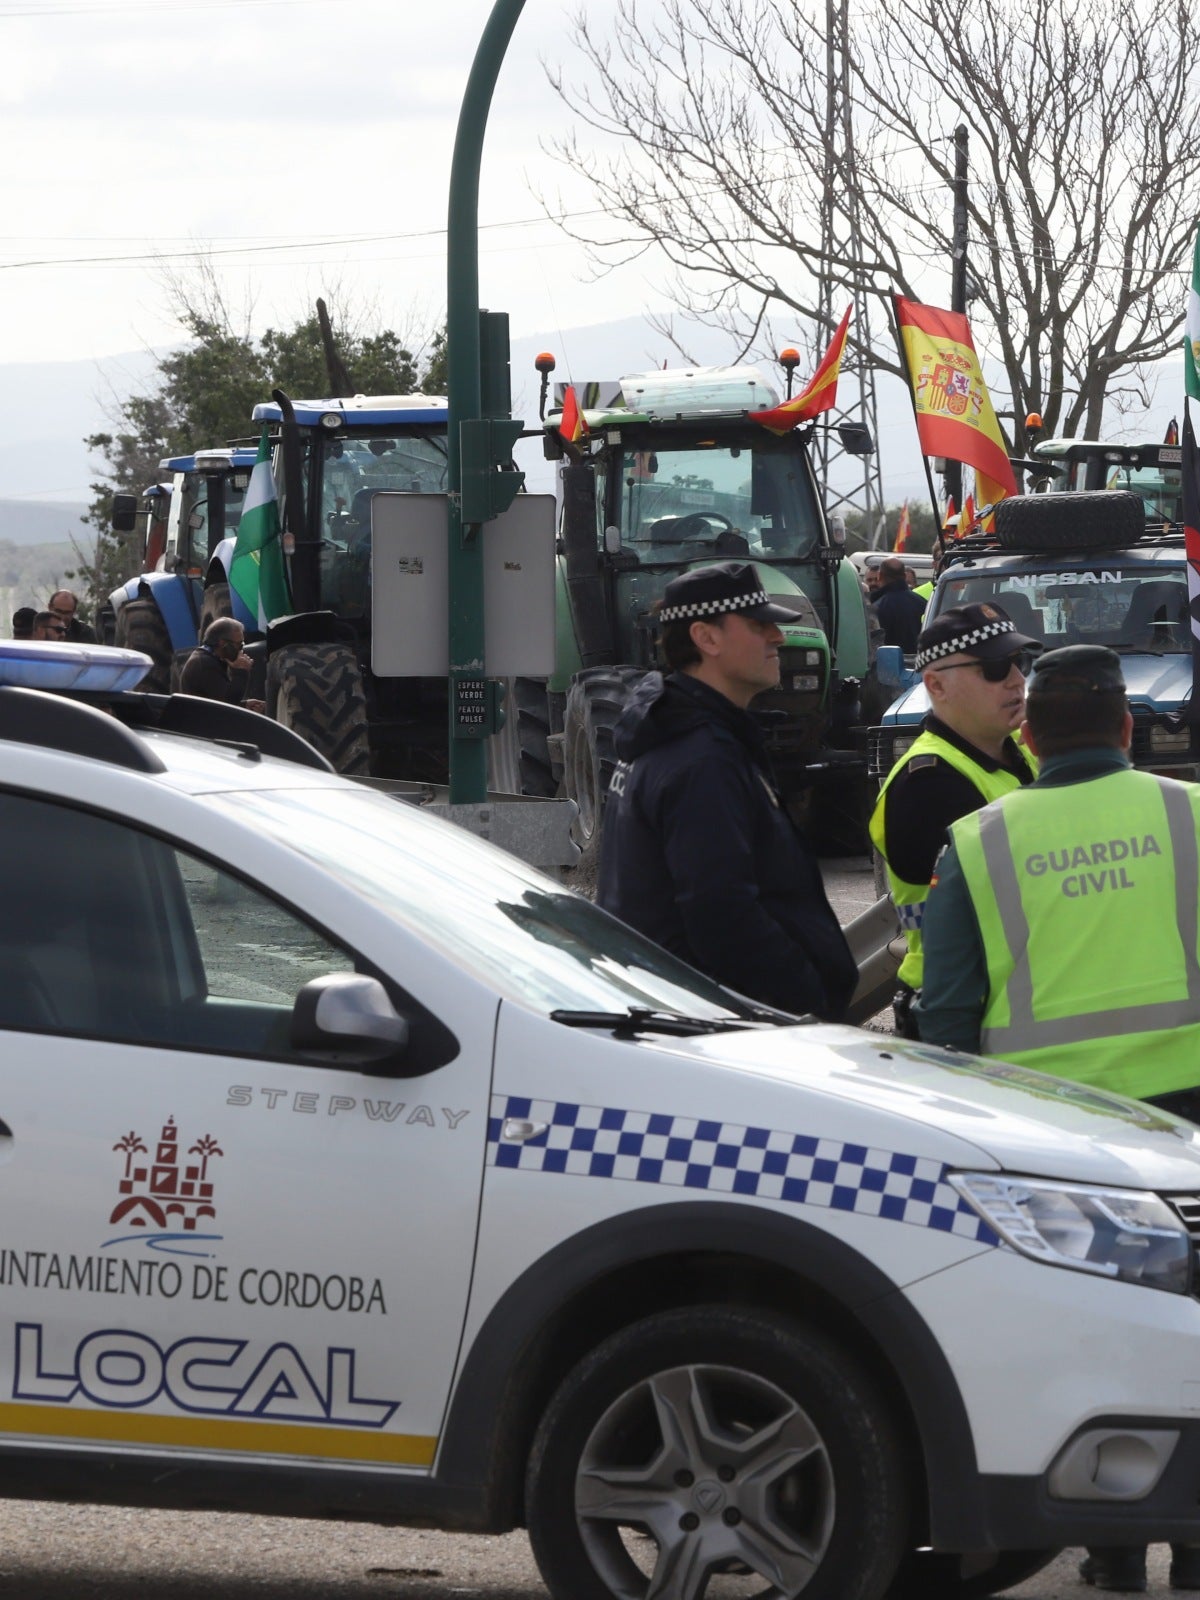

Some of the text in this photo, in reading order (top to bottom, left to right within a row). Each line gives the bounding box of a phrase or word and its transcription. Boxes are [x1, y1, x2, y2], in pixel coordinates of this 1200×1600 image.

[1008, 571, 1122, 589] NISSAN
[458, 681, 485, 689] ESPERE
[459, 691, 484, 699] VERDE
[460, 715, 483, 723] PULSE
[1025, 835, 1162, 876] GUARDIA
[1061, 867, 1135, 898] CIVIL
[226, 1085, 470, 1130] STEPWAY
[192, 1265, 228, 1301] DE
[239, 1268, 387, 1314] CORDOBA
[12, 1322, 402, 1428] LOCAL
